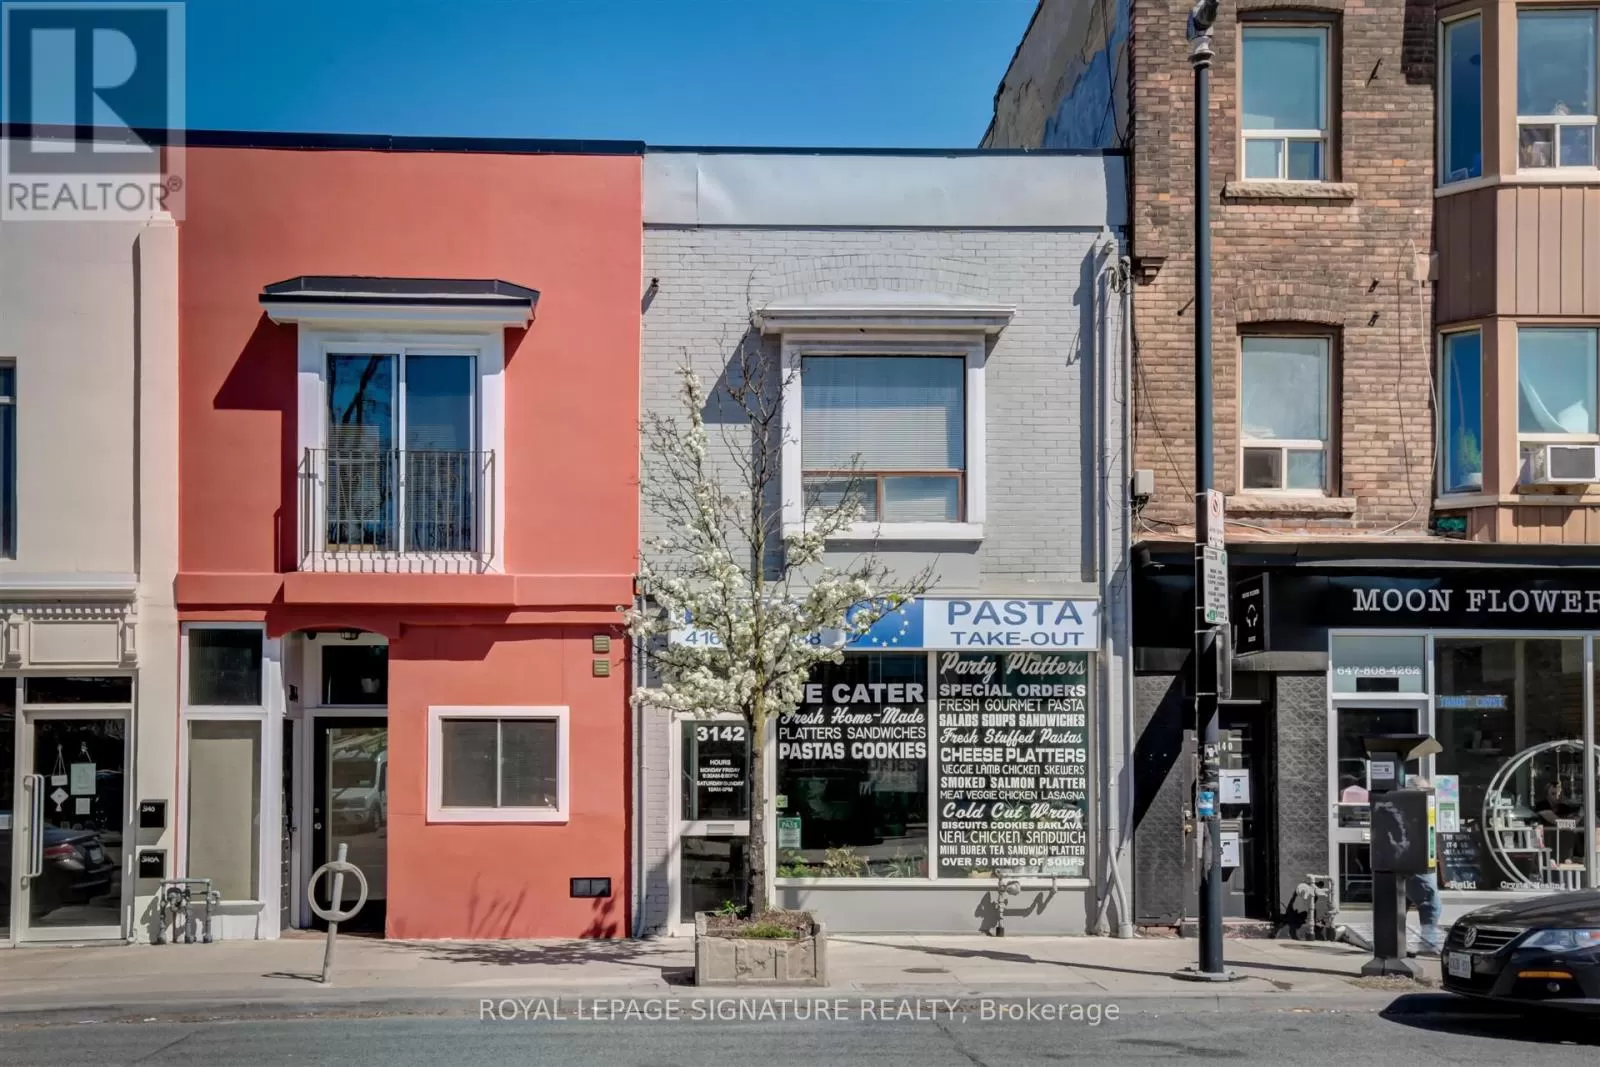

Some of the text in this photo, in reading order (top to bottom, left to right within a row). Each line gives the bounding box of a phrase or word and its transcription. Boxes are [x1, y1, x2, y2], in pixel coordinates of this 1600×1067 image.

[1352, 588, 1453, 612] MOON
[947, 600, 1083, 626] PASTA
[950, 631, 1085, 646] TAKE-OUT
[940, 652, 1086, 684] Party Platters
[831, 683, 925, 704] CATER
[939, 684, 1086, 697] SPECIAL ORDERS
[939, 699, 1085, 712] FRESH GOURMET PASTA
[831, 706, 925, 725] Home-Made
[939, 713, 1085, 727] SALADS SOUPS SANDWICHES
[697, 726, 745, 741] 3142
[779, 727, 926, 740] PLATTERS SANDWICHES
[940, 728, 1083, 747] Fresh Stuffed Pastas
[779, 742, 926, 760] PASTAS COOKIES
[940, 747, 1086, 763] CHEESE PLATTERS
[942, 764, 1085, 775] VEGGIE LAMB CHICKEN SKEWERS
[940, 777, 1086, 789] SMOKED SALMON PLATTER
[940, 790, 1085, 800] MEAT VEGGIE CHICKEN LASAGNA
[943, 802, 1083, 824] Cold Cut Wraps
[941, 821, 1083, 830] BISCUITS COOKIES BAKLAVA
[939, 830, 1086, 844] VEAL CHICKEN SANDWICH
[940, 845, 1085, 856] MINI BUREK TEA SANDWICH PLATTER
[941, 857, 1085, 866] OVER 50 KINDS OF SOUPS
[1450, 881, 1477, 890] Reiki
